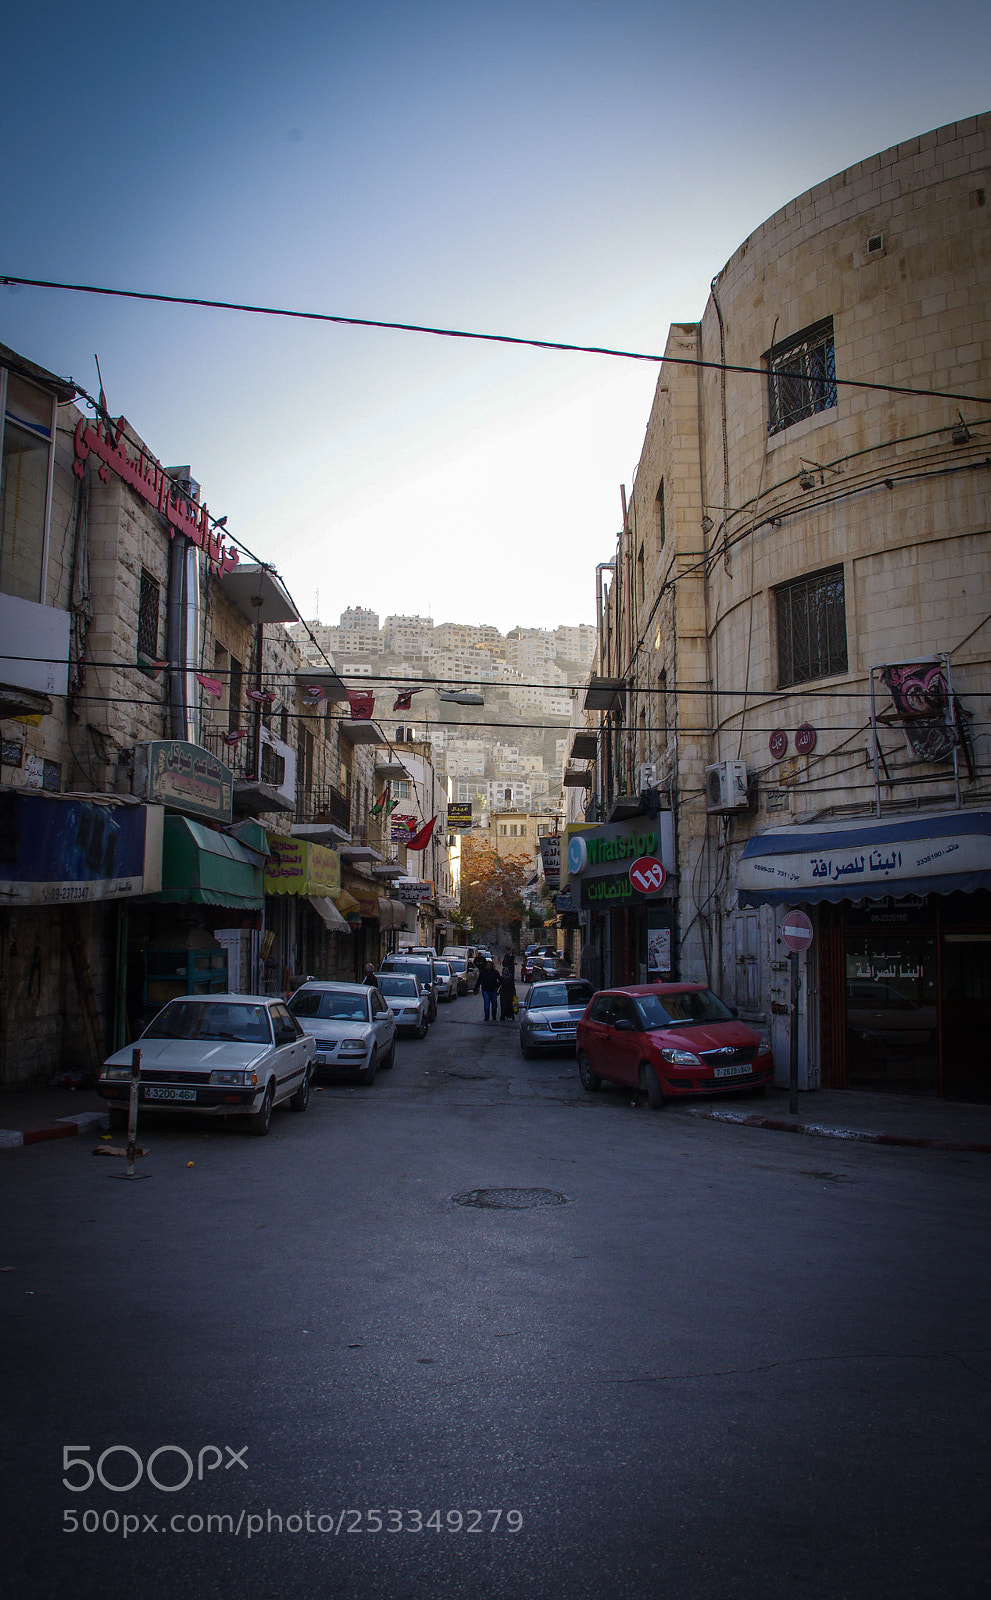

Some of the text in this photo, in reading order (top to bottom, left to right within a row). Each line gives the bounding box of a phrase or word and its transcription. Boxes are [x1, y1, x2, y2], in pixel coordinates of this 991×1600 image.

[586, 830, 659, 864] WhatsApp
[264, 867, 303, 878] التجارية
[811, 858, 865, 881] للصرافة
[856, 962, 924, 982] البنا للصرافة
